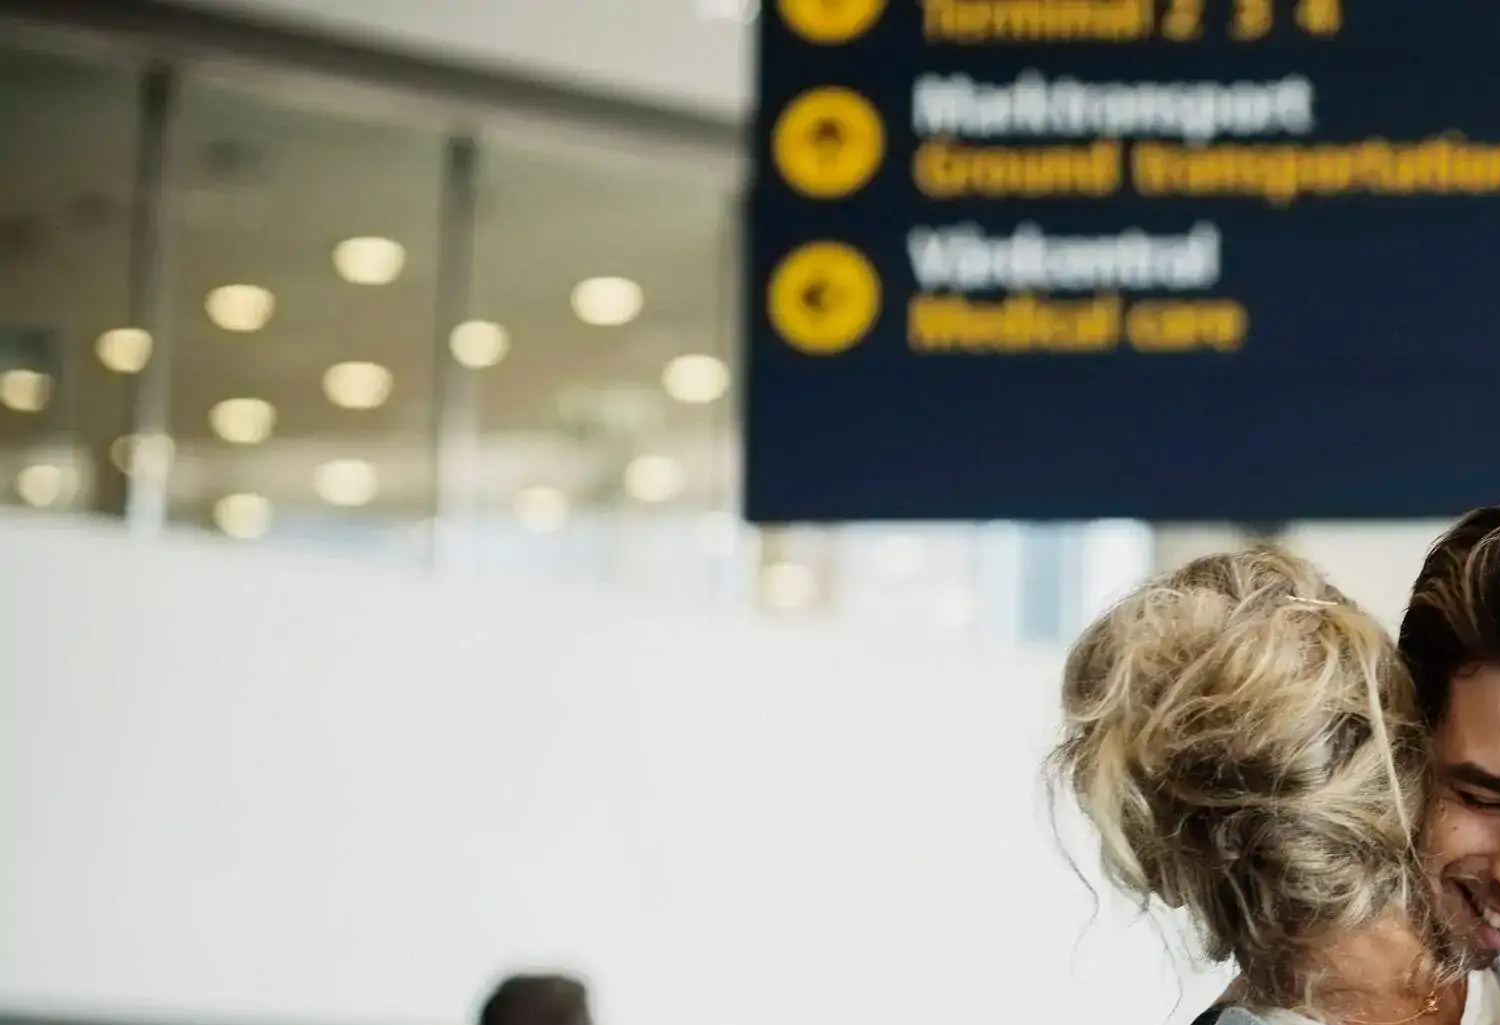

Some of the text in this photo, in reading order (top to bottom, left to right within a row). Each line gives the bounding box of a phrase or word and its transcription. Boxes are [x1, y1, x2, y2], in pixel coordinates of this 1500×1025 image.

[922, 0, 1156, 40] Terminal
[912, 75, 1314, 141] Marktransport
[914, 142, 1122, 197] Ground
[907, 226, 1222, 290] Vårdcentral
[908, 299, 1246, 351] Medical care
